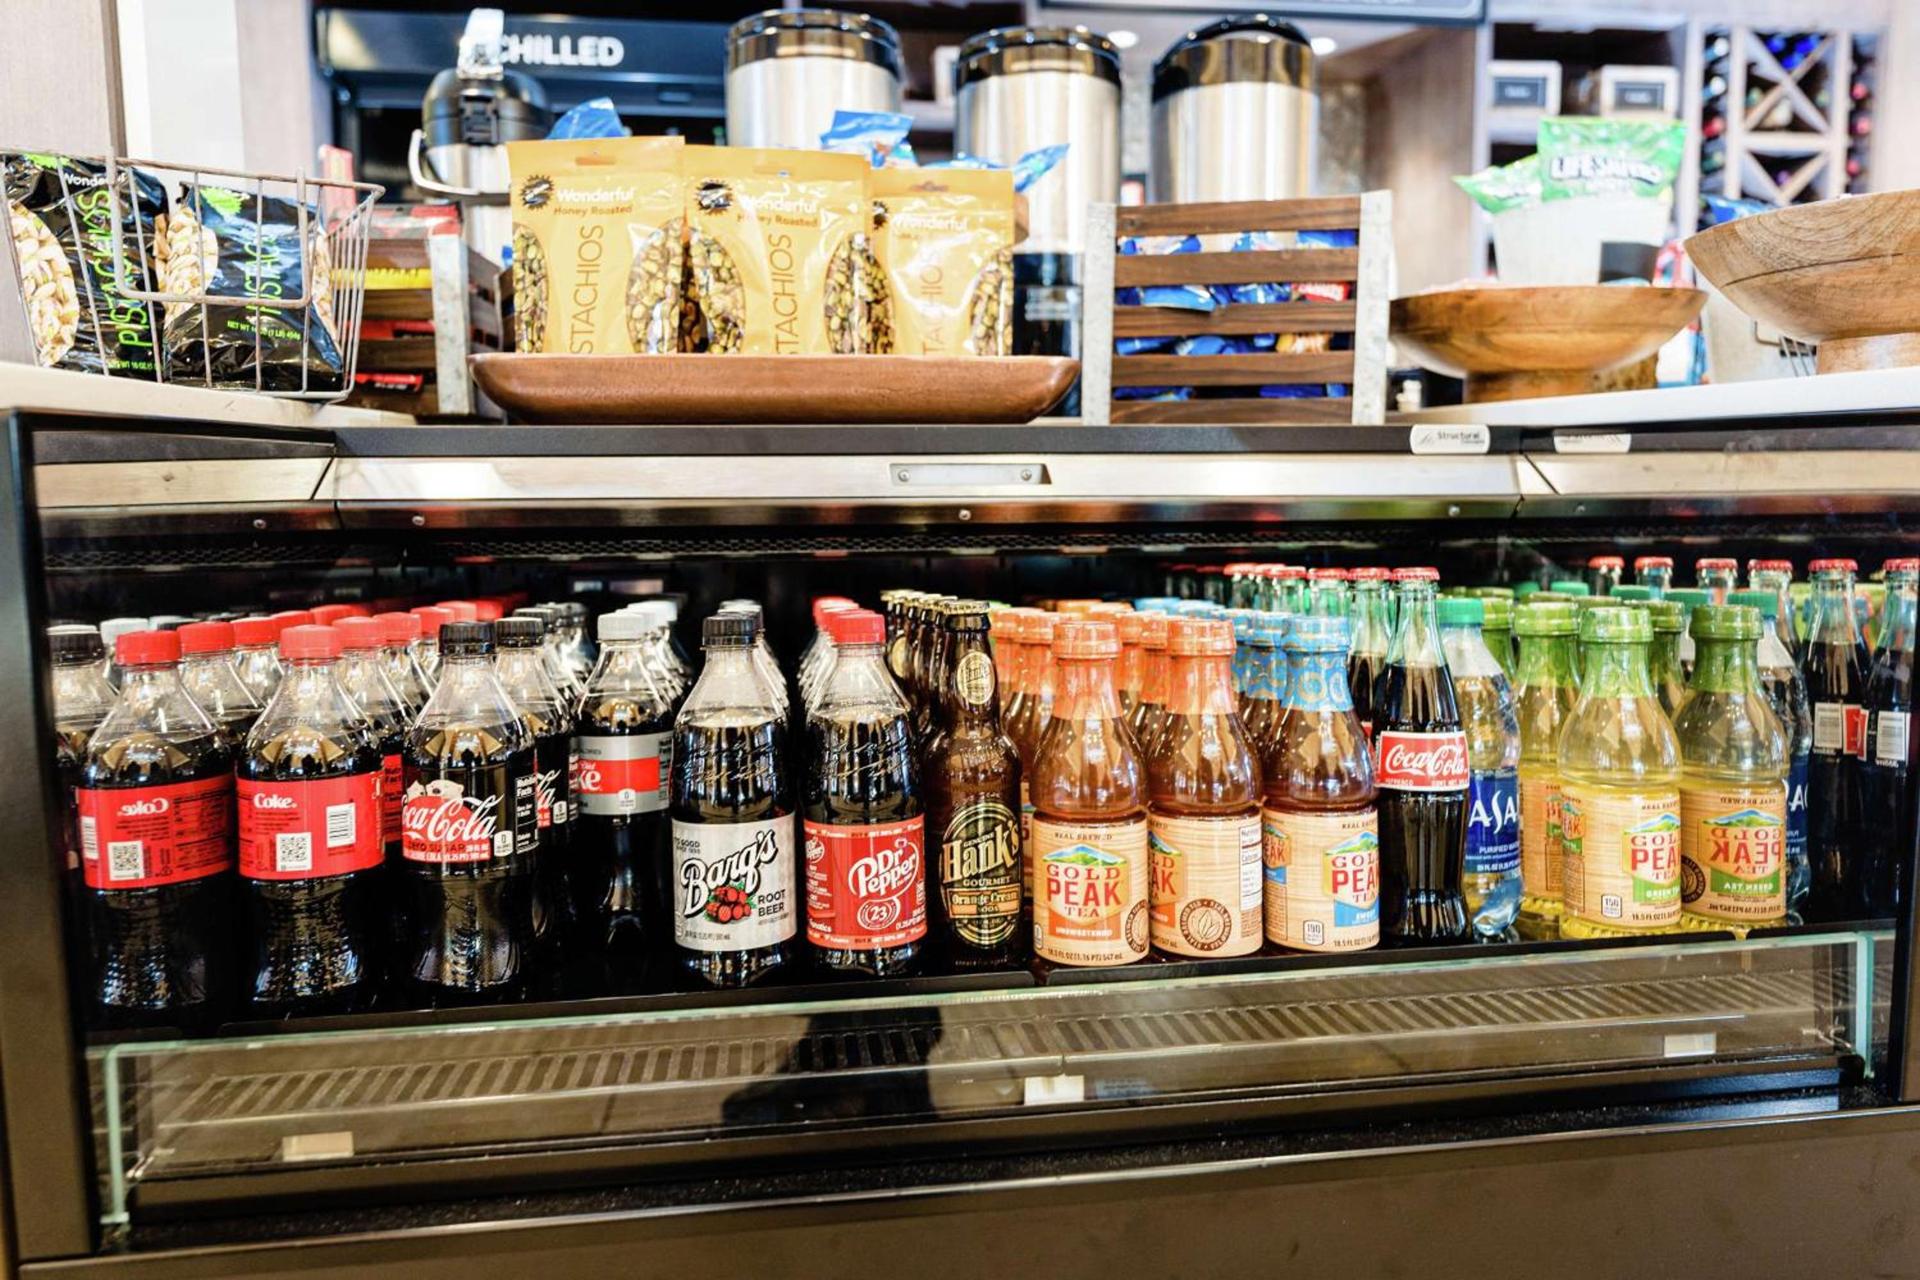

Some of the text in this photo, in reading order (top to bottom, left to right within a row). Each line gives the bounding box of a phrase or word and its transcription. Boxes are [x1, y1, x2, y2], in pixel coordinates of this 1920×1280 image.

[557, 188, 635, 203] Wonderful
[554, 206, 633, 217] Honey Roasted
[775, 215, 818, 228] Roasted
[569, 225, 604, 354] STACHIOS
[768, 233, 800, 354] TACHIOS
[254, 793, 293, 809] Coke
[1469, 790, 1517, 835] ASA
[942, 819, 1020, 884] Hank's
[1631, 846, 1681, 871] PEA
[878, 848, 903, 874] Dr
[1331, 852, 1378, 868] GOL
[680, 829, 779, 919] Barq's
[857, 853, 916, 898] Pepper
[1046, 864, 1121, 880] GOLD
[1331, 866, 1379, 894] PEA
[962, 876, 1011, 888] GOURMET
[758, 889, 786, 905] ROOT
[1046, 878, 1122, 907] PEAK
[758, 902, 785, 917] BEER
[871, 905, 888, 921] 23
[1065, 907, 1100, 917] TEA
